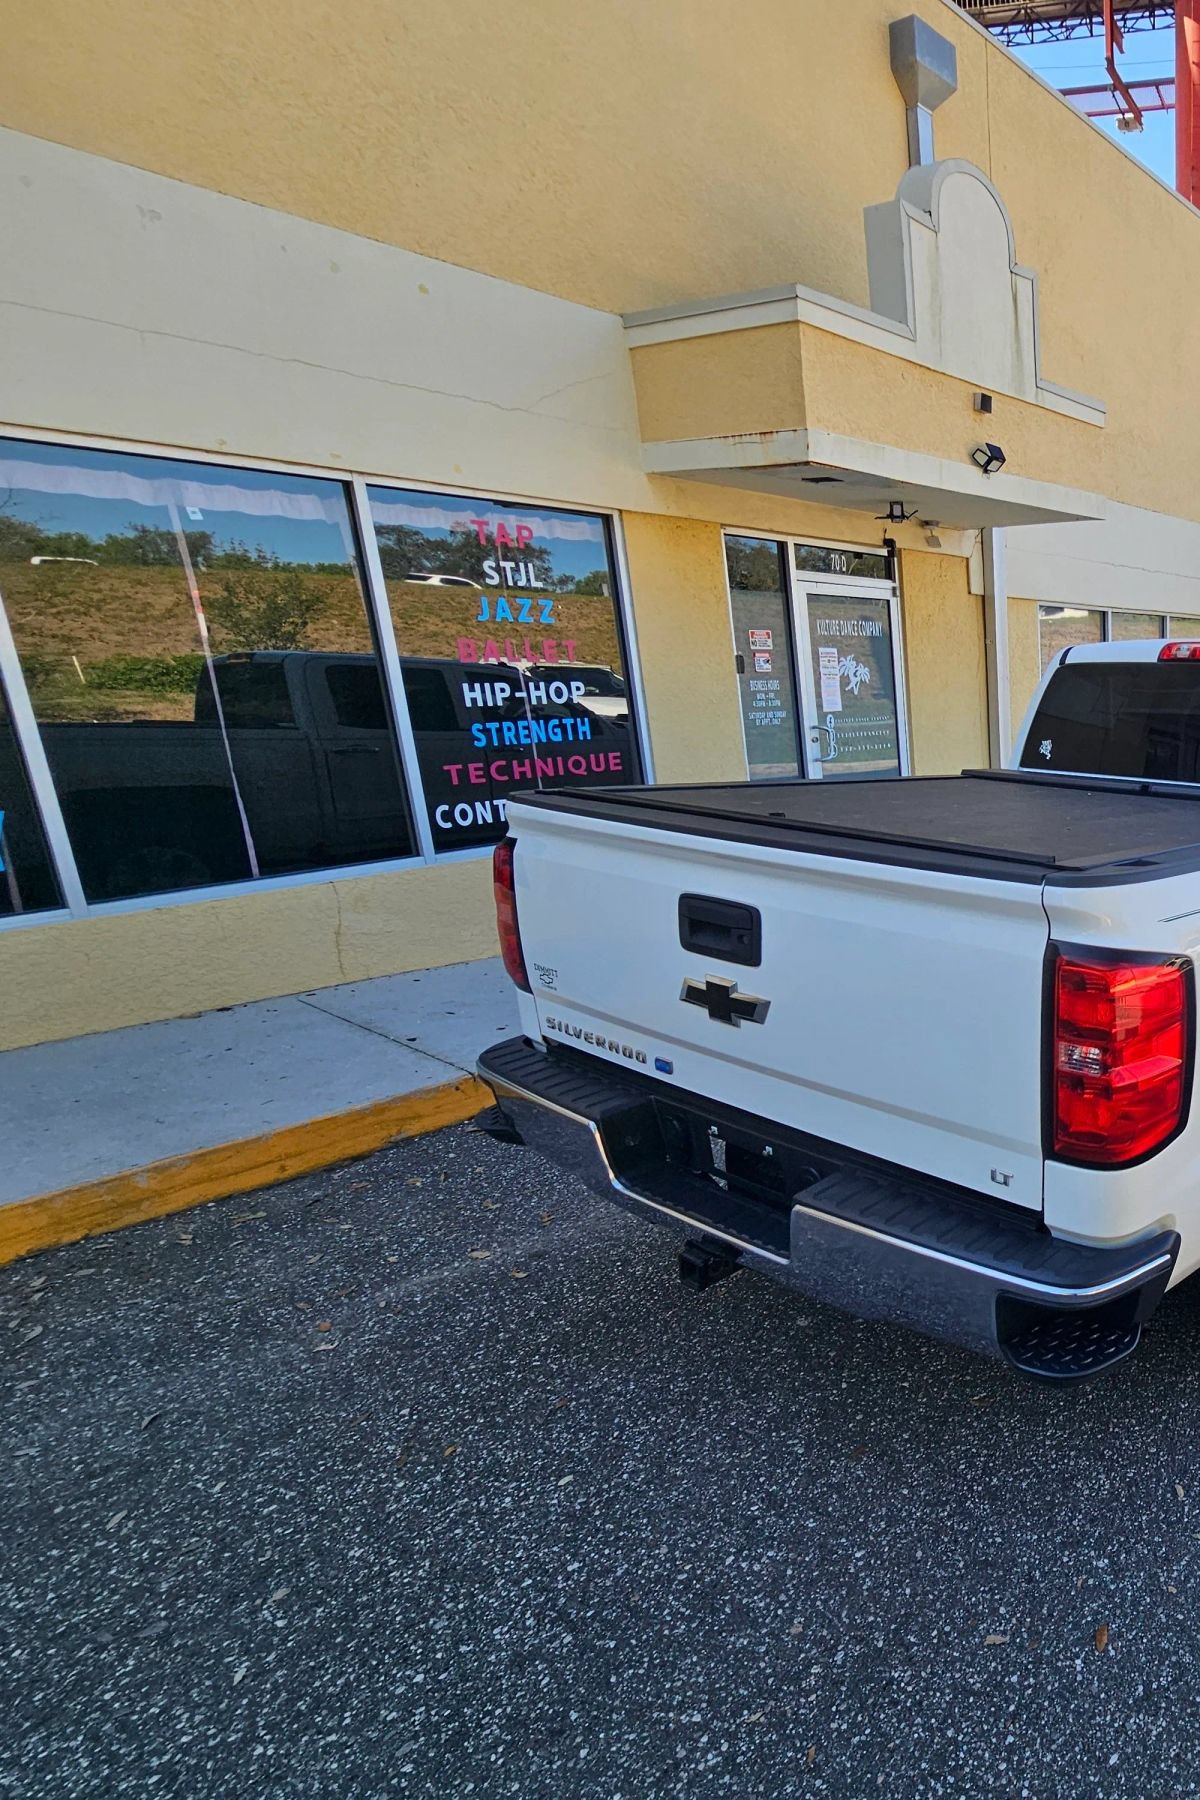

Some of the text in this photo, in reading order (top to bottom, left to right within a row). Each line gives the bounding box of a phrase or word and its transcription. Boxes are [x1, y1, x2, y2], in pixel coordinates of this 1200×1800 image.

[470, 519, 533, 549] TAP
[482, 560, 543, 588] STJL
[477, 596, 555, 624] JAZZ
[840, 620, 858, 637] DANCE
[858, 620, 883, 637] COMPANY
[457, 638, 577, 664] BALLET
[462, 681, 586, 708] HIP-HOP
[471, 718, 591, 748] STRENGTH
[443, 752, 623, 785] TECHNIQUE
[546, 1016, 648, 1064] SILVERADO
[990, 1168, 1014, 1187] LT
